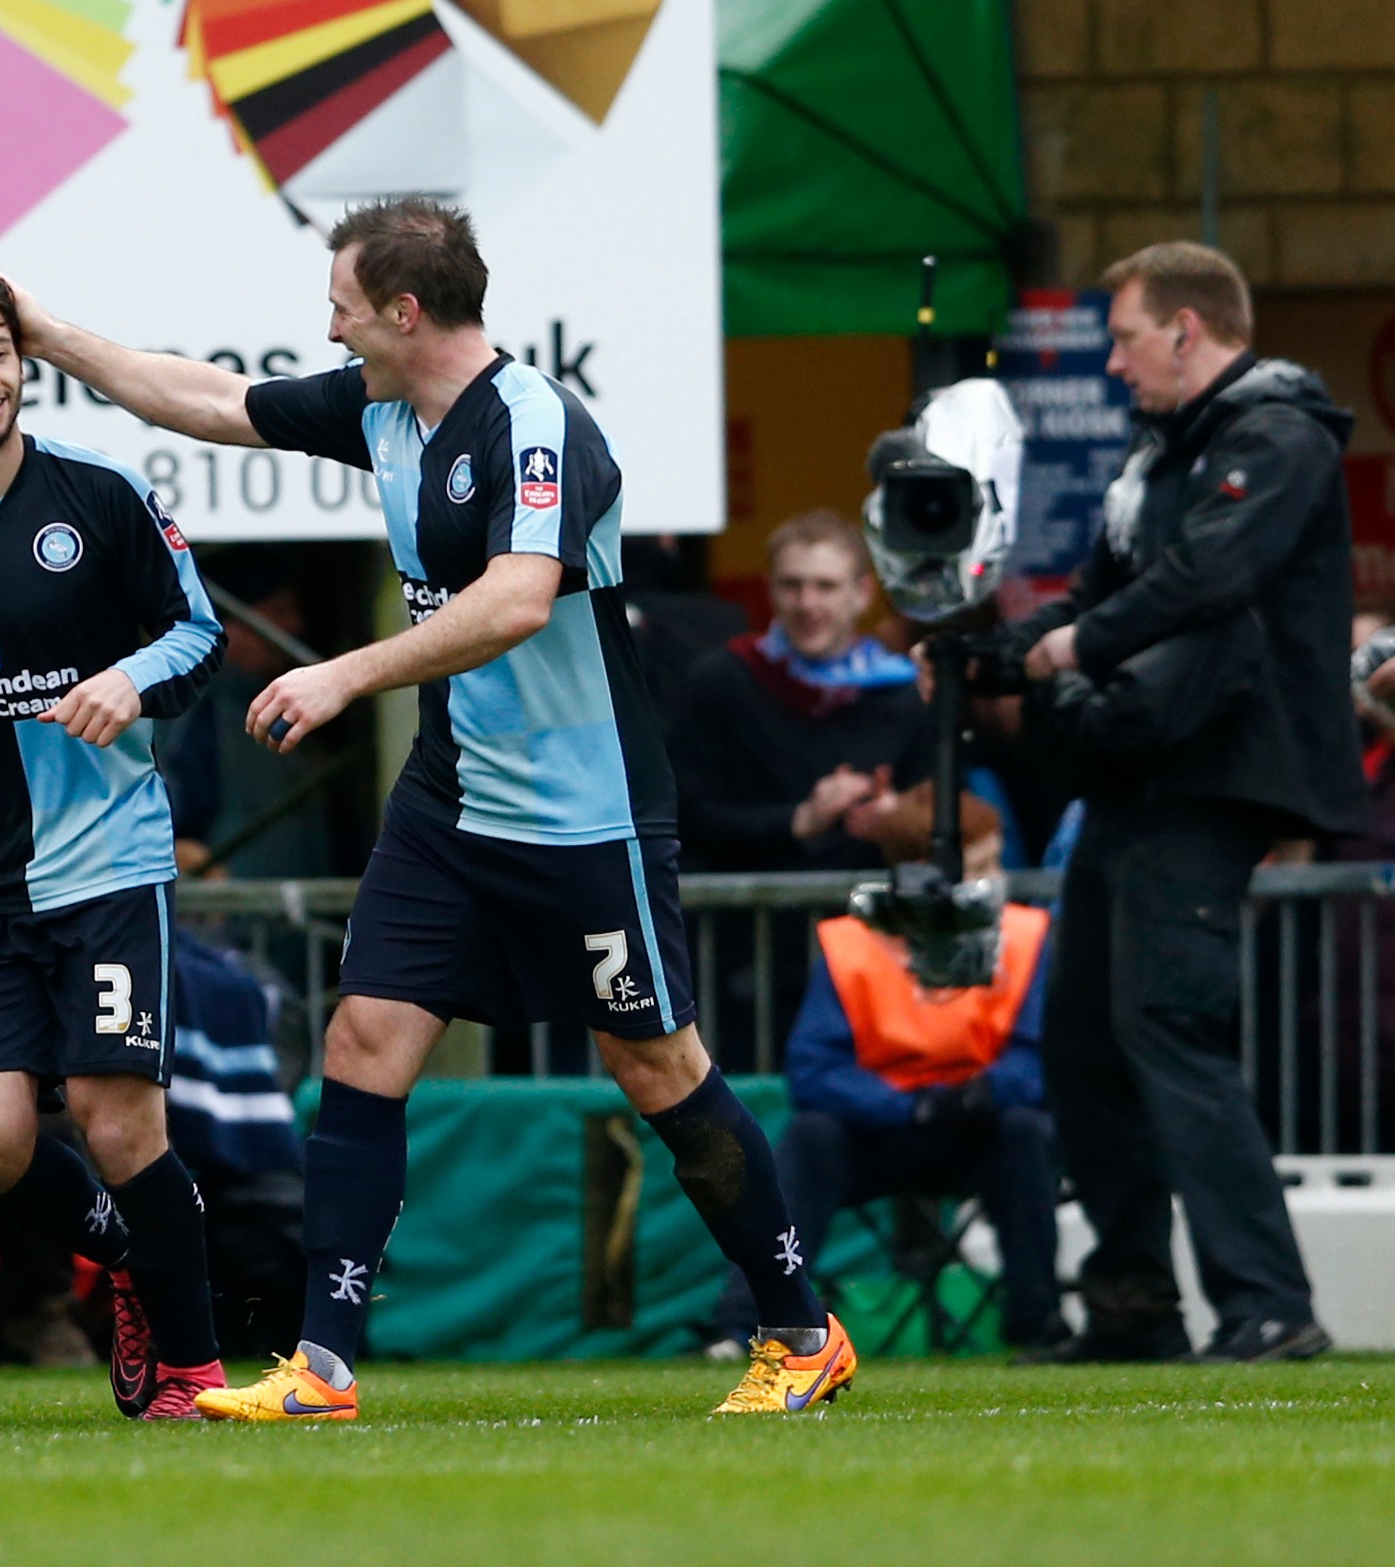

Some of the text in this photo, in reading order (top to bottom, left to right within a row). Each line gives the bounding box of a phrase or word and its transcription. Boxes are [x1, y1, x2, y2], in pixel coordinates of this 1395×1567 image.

[144, 449, 281, 512] 810
[584, 929, 628, 999] 7
[94, 963, 132, 1034] 3
[607, 996, 655, 1012] KUKRI
[125, 1035, 161, 1050] KUKR
